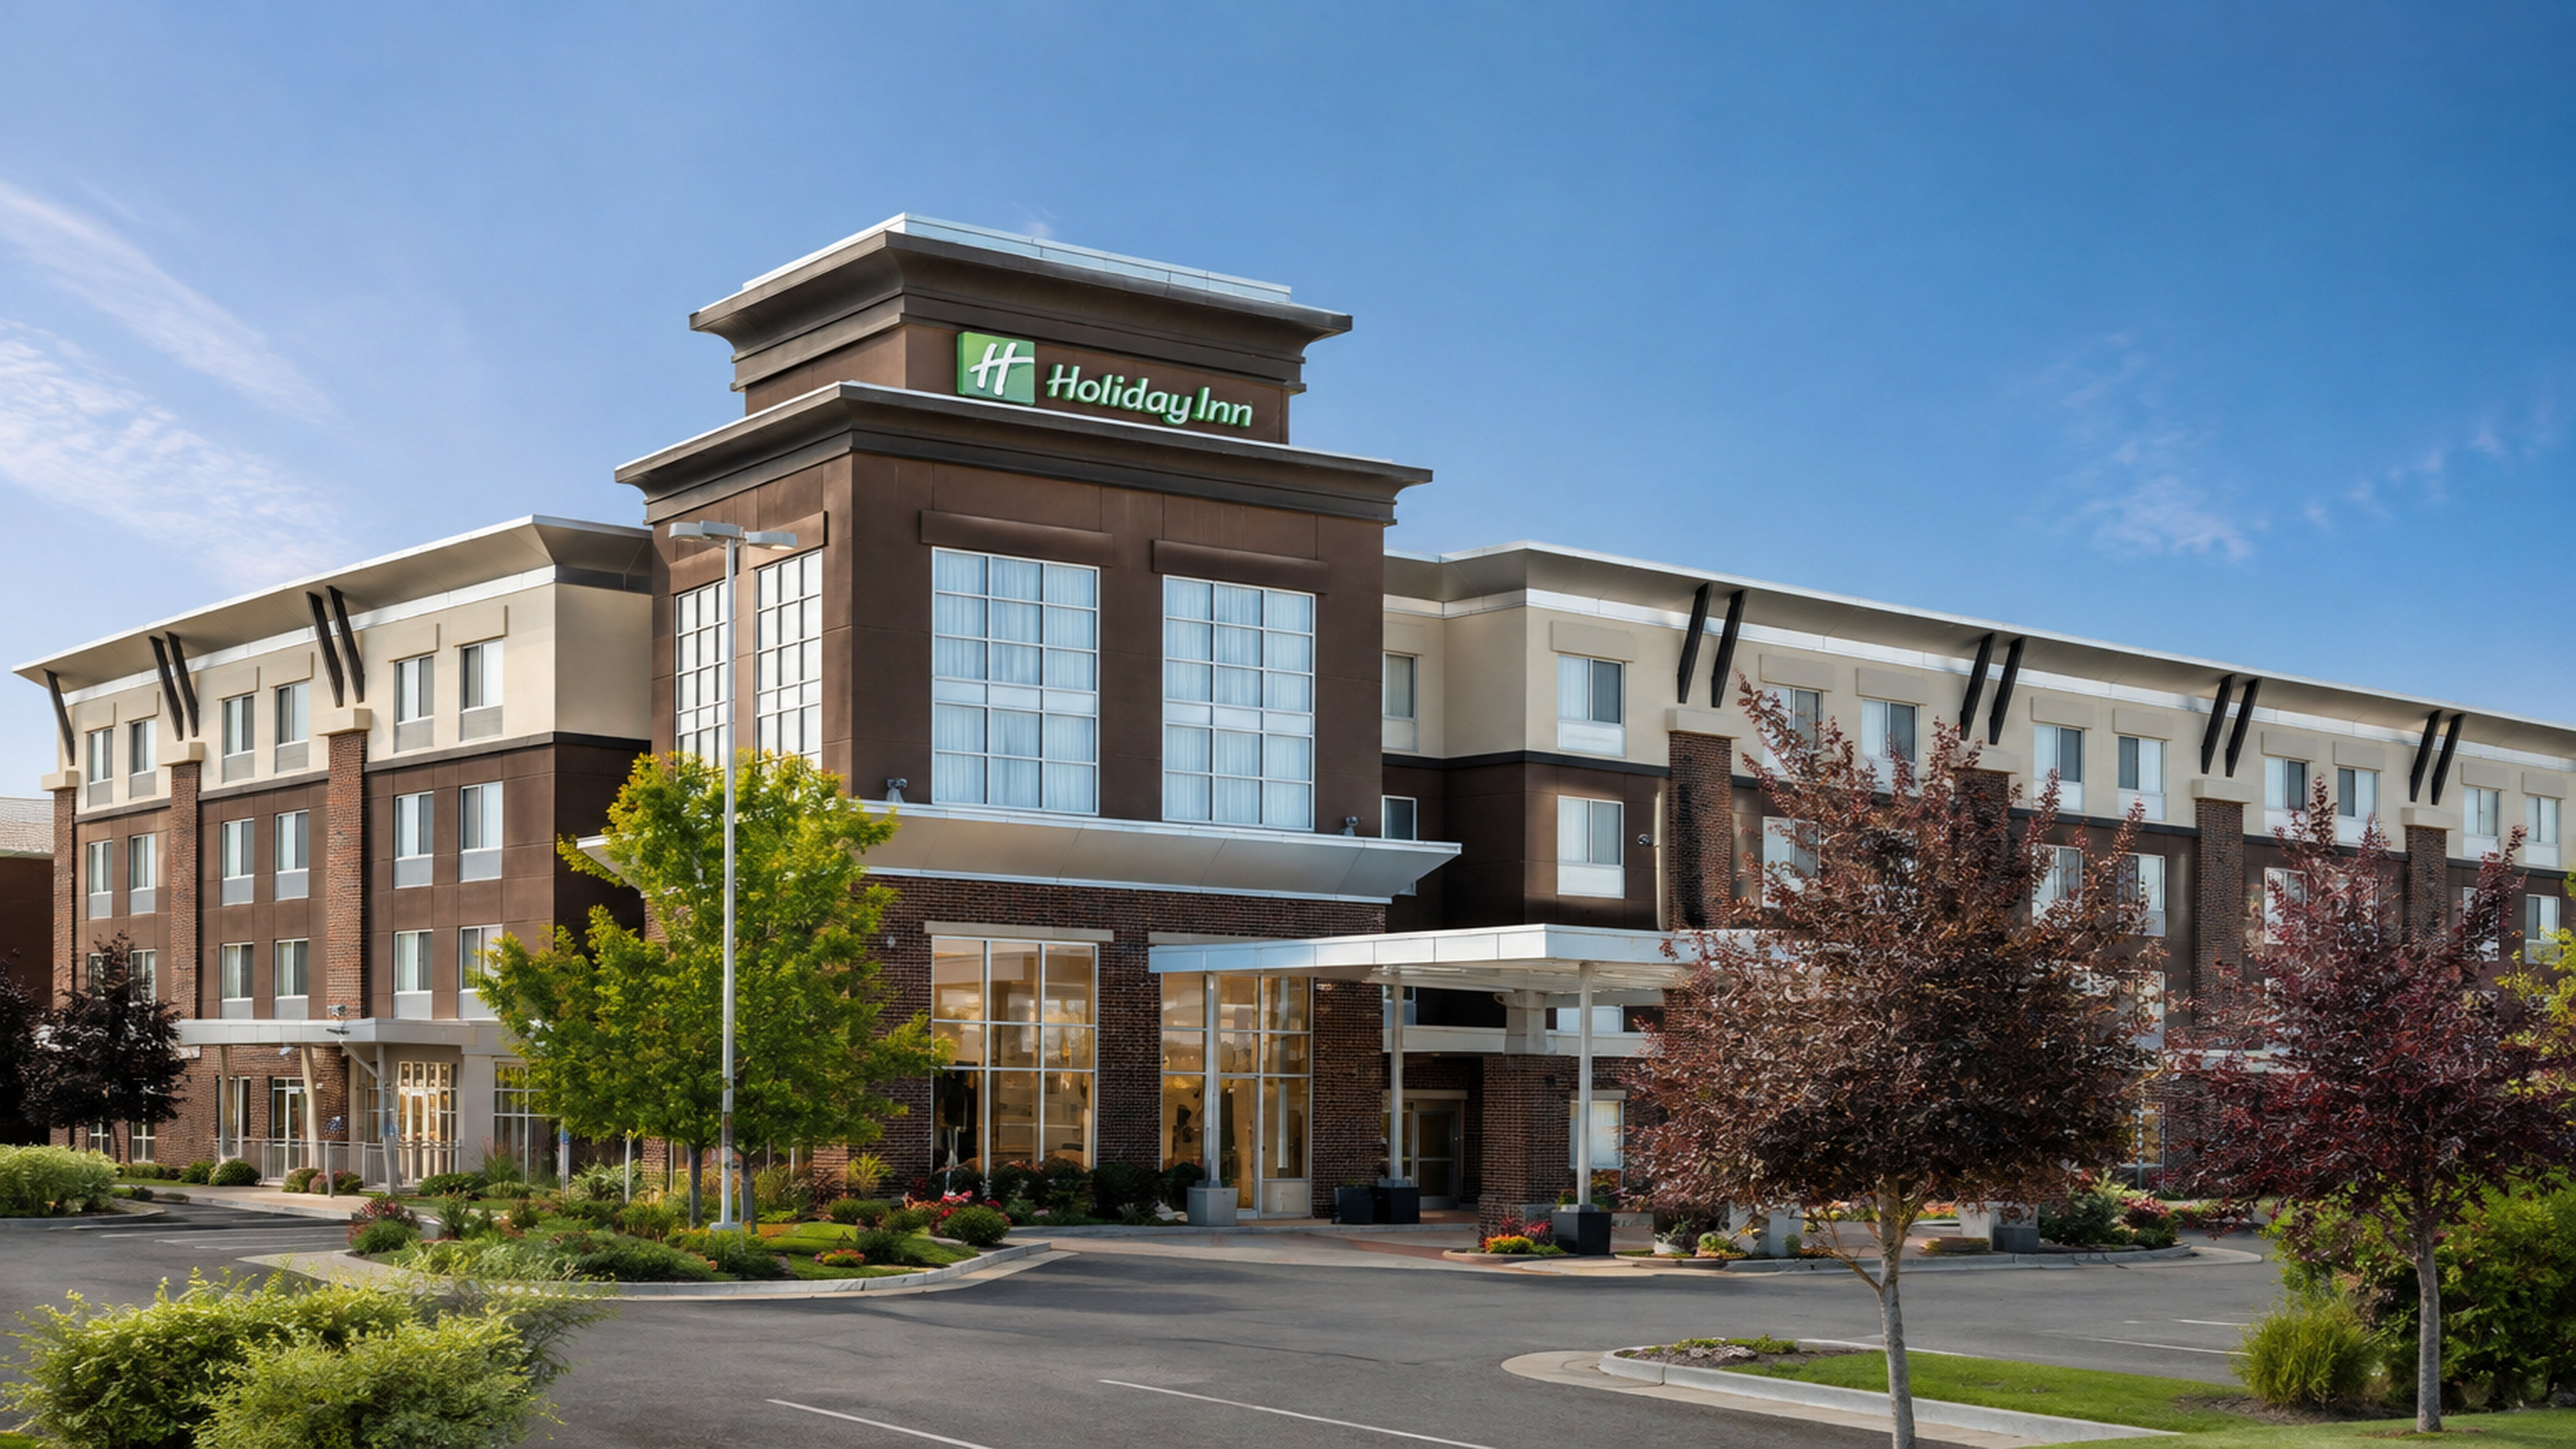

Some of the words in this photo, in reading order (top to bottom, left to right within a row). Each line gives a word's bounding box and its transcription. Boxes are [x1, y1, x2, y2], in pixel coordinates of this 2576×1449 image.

[969, 342, 1034, 396] H
[1046, 364, 1192, 425] Holiday
[1191, 386, 1253, 427] Inn
